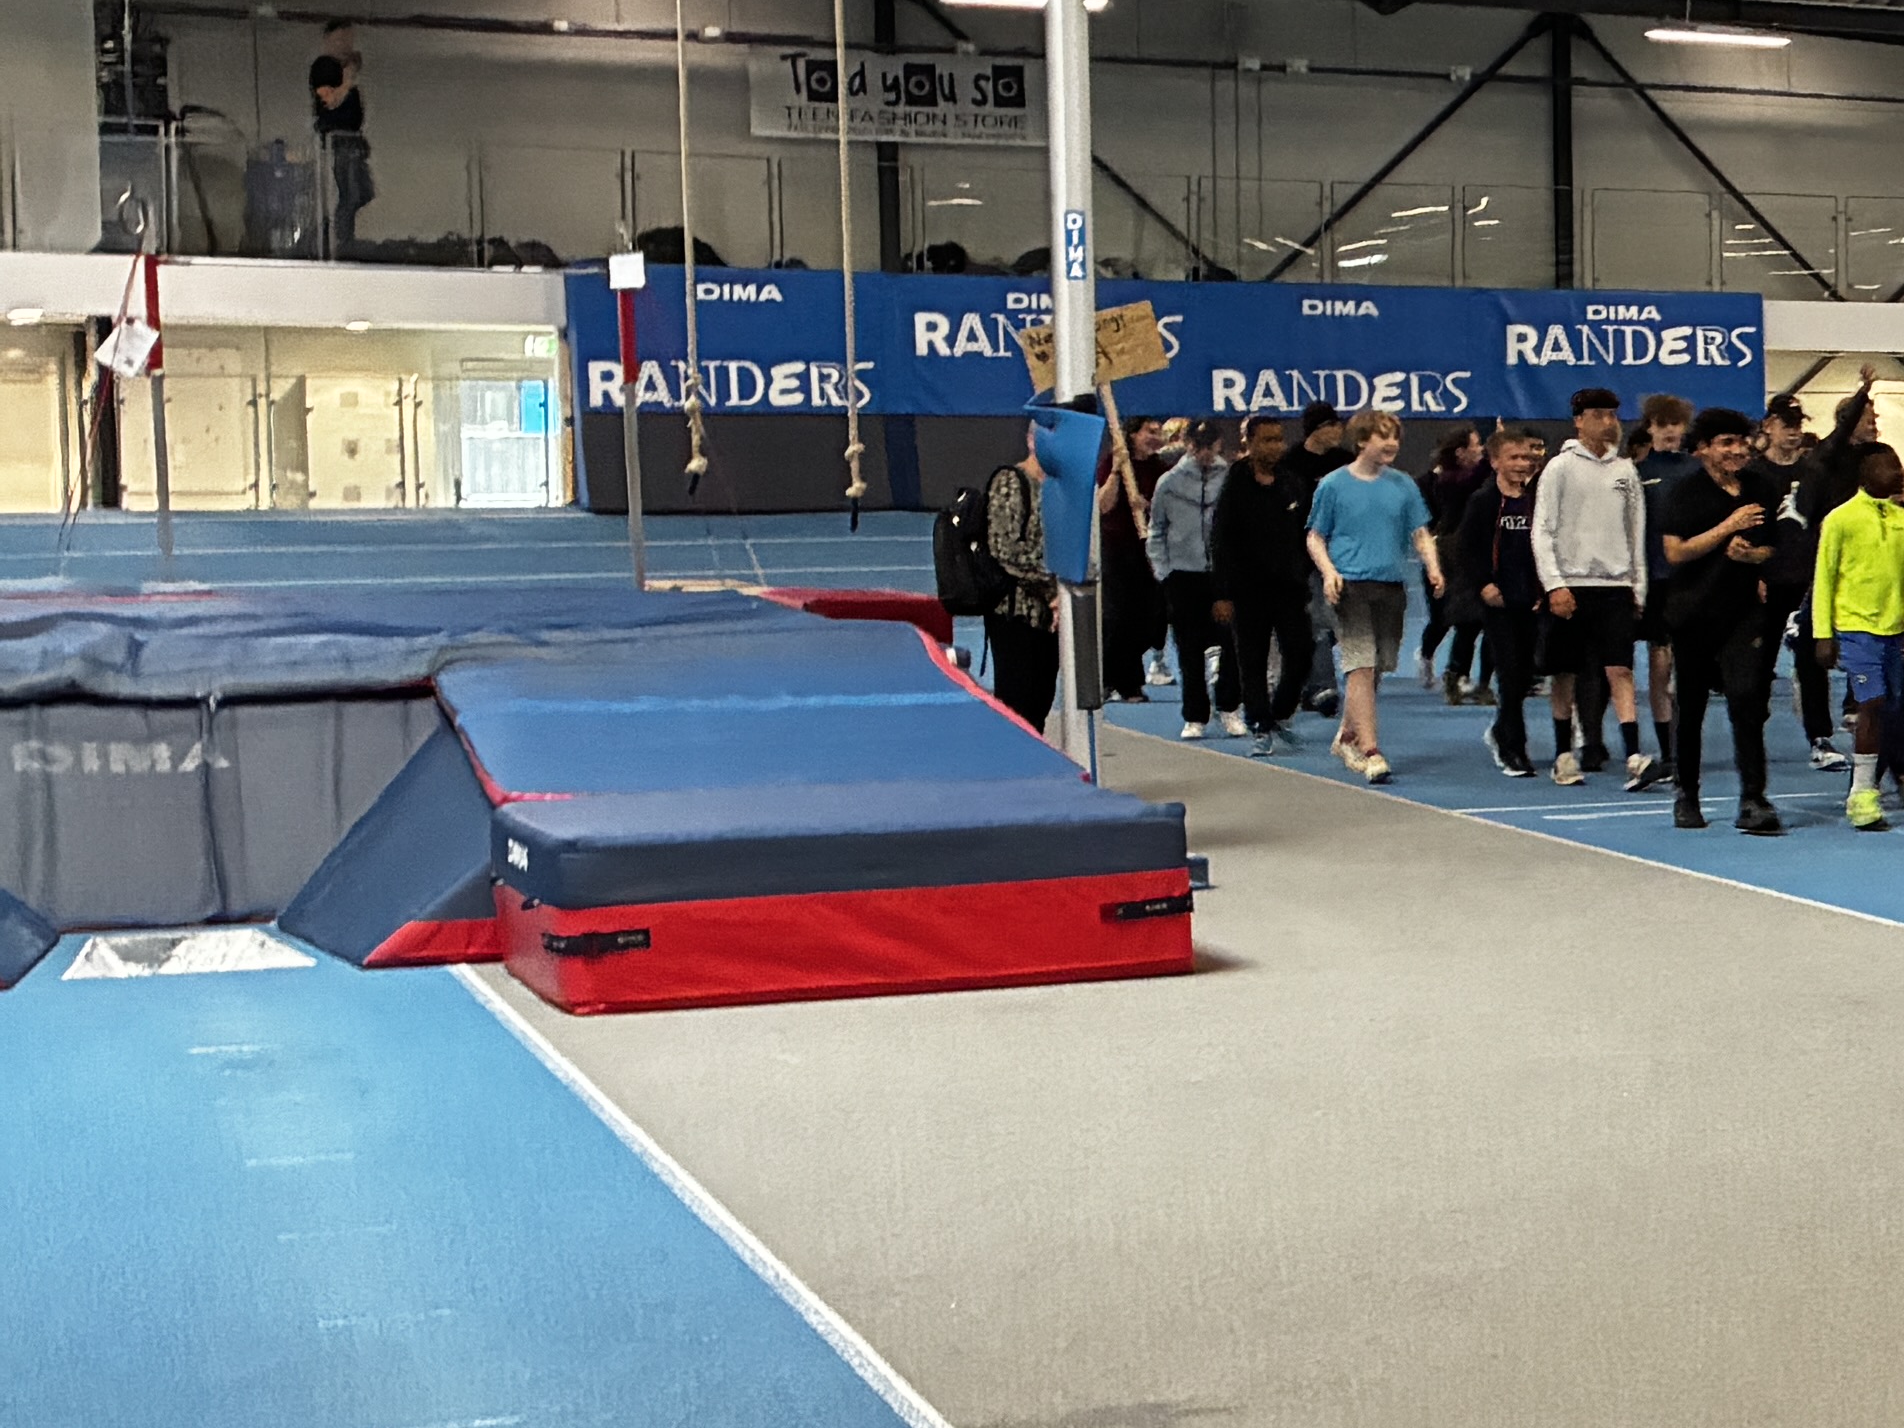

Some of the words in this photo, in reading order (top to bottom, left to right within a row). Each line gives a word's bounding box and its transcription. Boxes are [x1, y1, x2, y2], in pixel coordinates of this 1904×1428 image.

[696, 282, 783, 303] DIMA
[1006, 292, 1053, 310] DIM
[1301, 298, 1379, 317] DIMA
[1585, 304, 1662, 321] DIMA
[914, 311, 1184, 359] RANS
[1506, 324, 1757, 368] RANDERS
[587, 360, 875, 409] RANDERS
[1212, 369, 1472, 413] RANDERS
